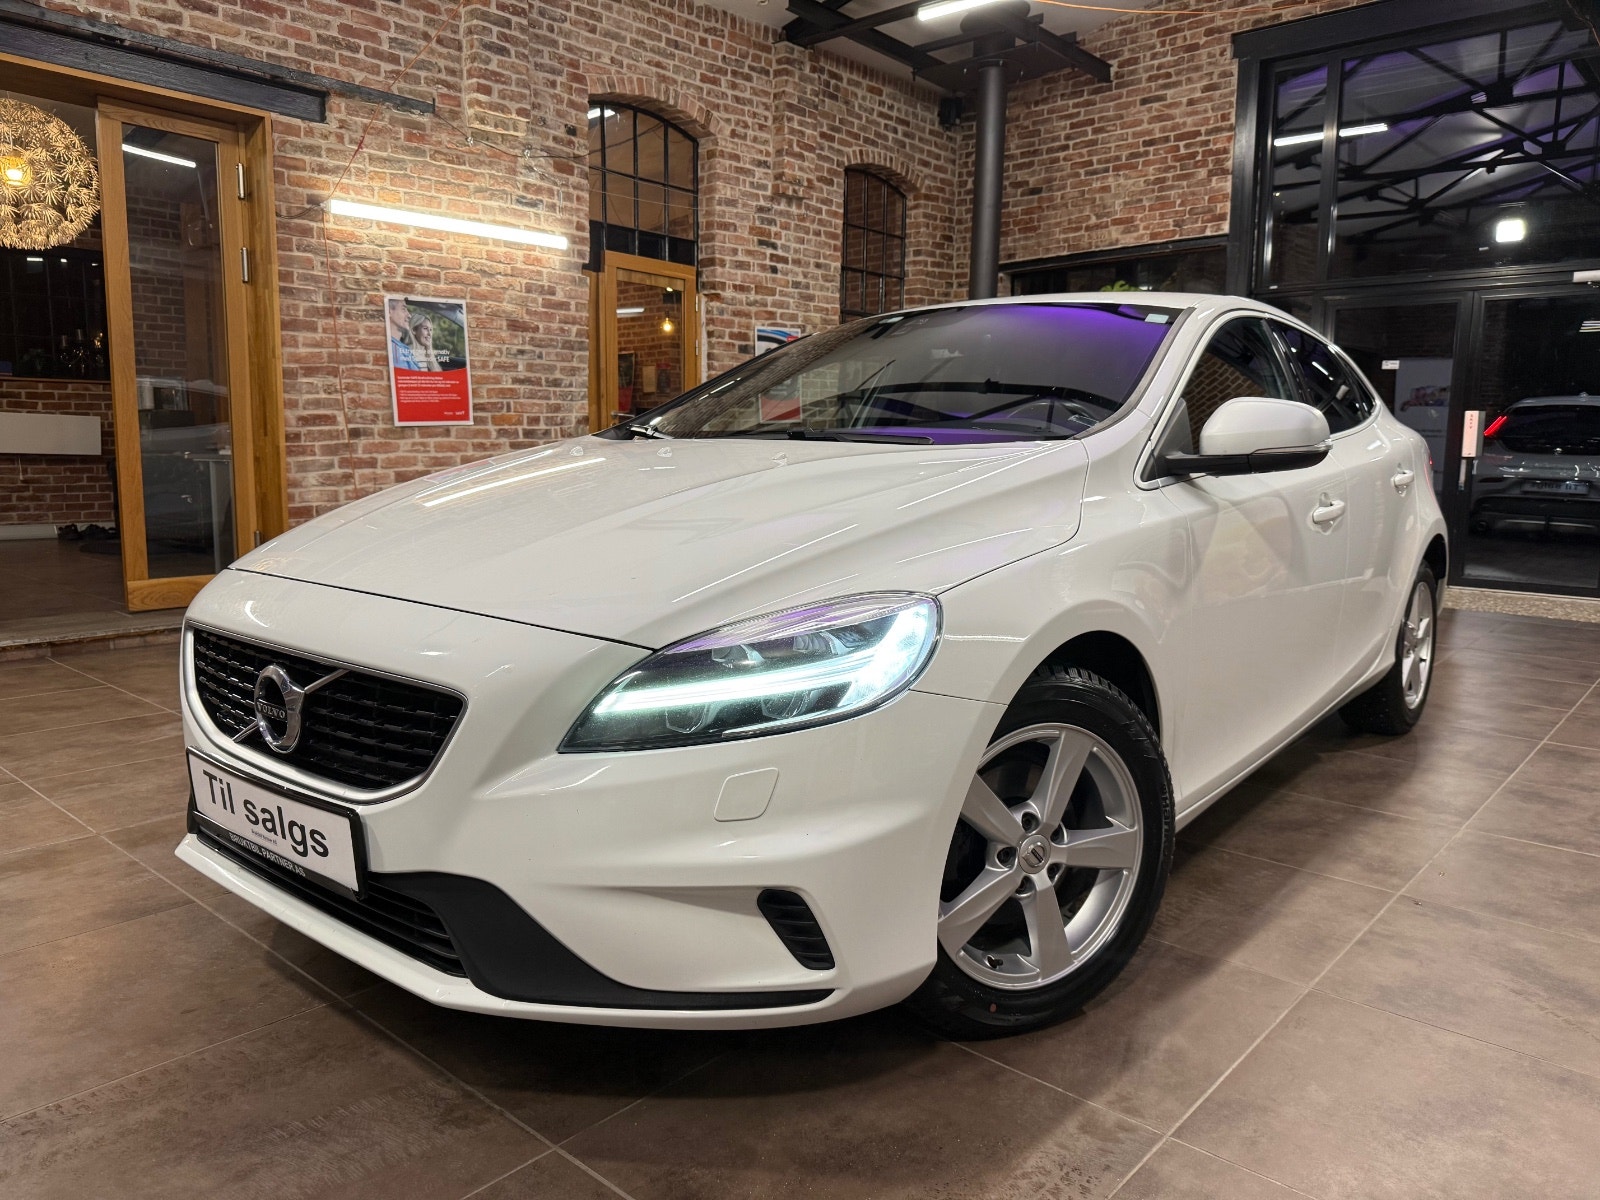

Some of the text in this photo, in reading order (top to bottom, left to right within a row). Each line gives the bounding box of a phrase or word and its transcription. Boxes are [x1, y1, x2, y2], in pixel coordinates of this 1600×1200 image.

[257, 702, 285, 719] VOLVO
[203, 769, 329, 858] Til salgs
[229, 832, 263, 856] BRUKTBIL
[262, 849, 295, 871] PARTNER
[294, 865, 306, 877] AS
